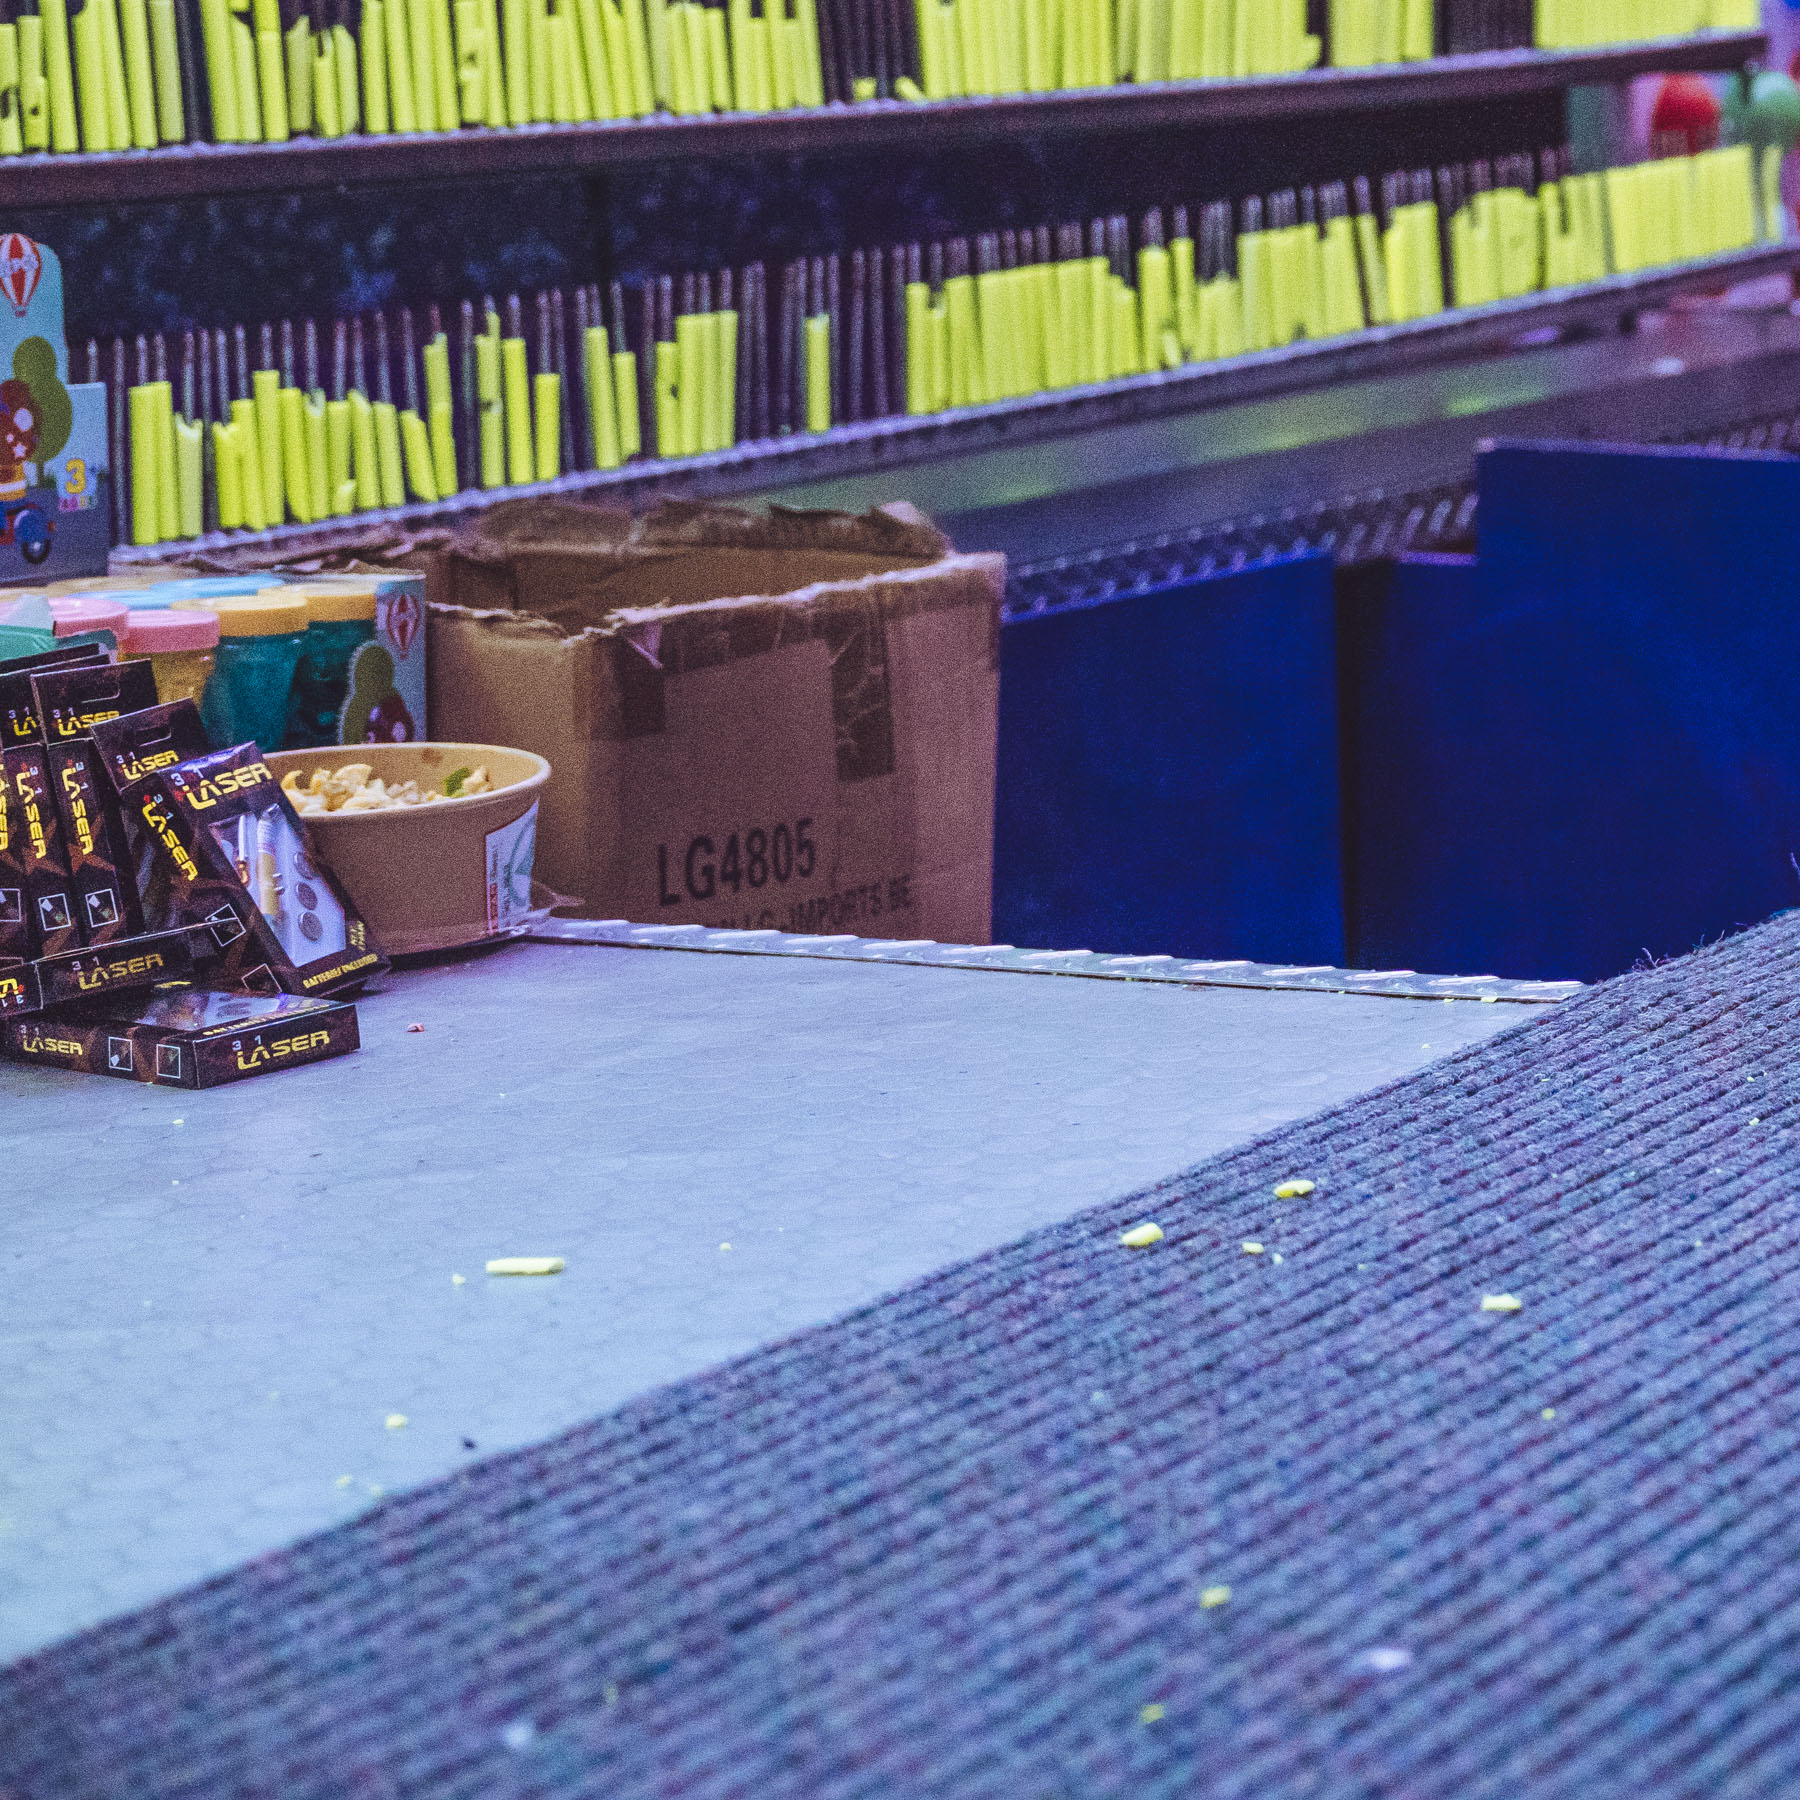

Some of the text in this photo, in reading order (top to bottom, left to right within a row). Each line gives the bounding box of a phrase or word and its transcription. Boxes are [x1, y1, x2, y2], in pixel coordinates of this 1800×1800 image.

[122, 750, 179, 780] LASER
[182, 762, 273, 810] LASER
[16, 771, 47, 859] LASER
[62, 767, 94, 855] LASER
[142, 801, 198, 881] LASER
[657, 817, 816, 907] LG4805
[78, 953, 164, 990] LASER
[23, 1034, 83, 1056] LASER
[237, 1030, 330, 1070] LASER
